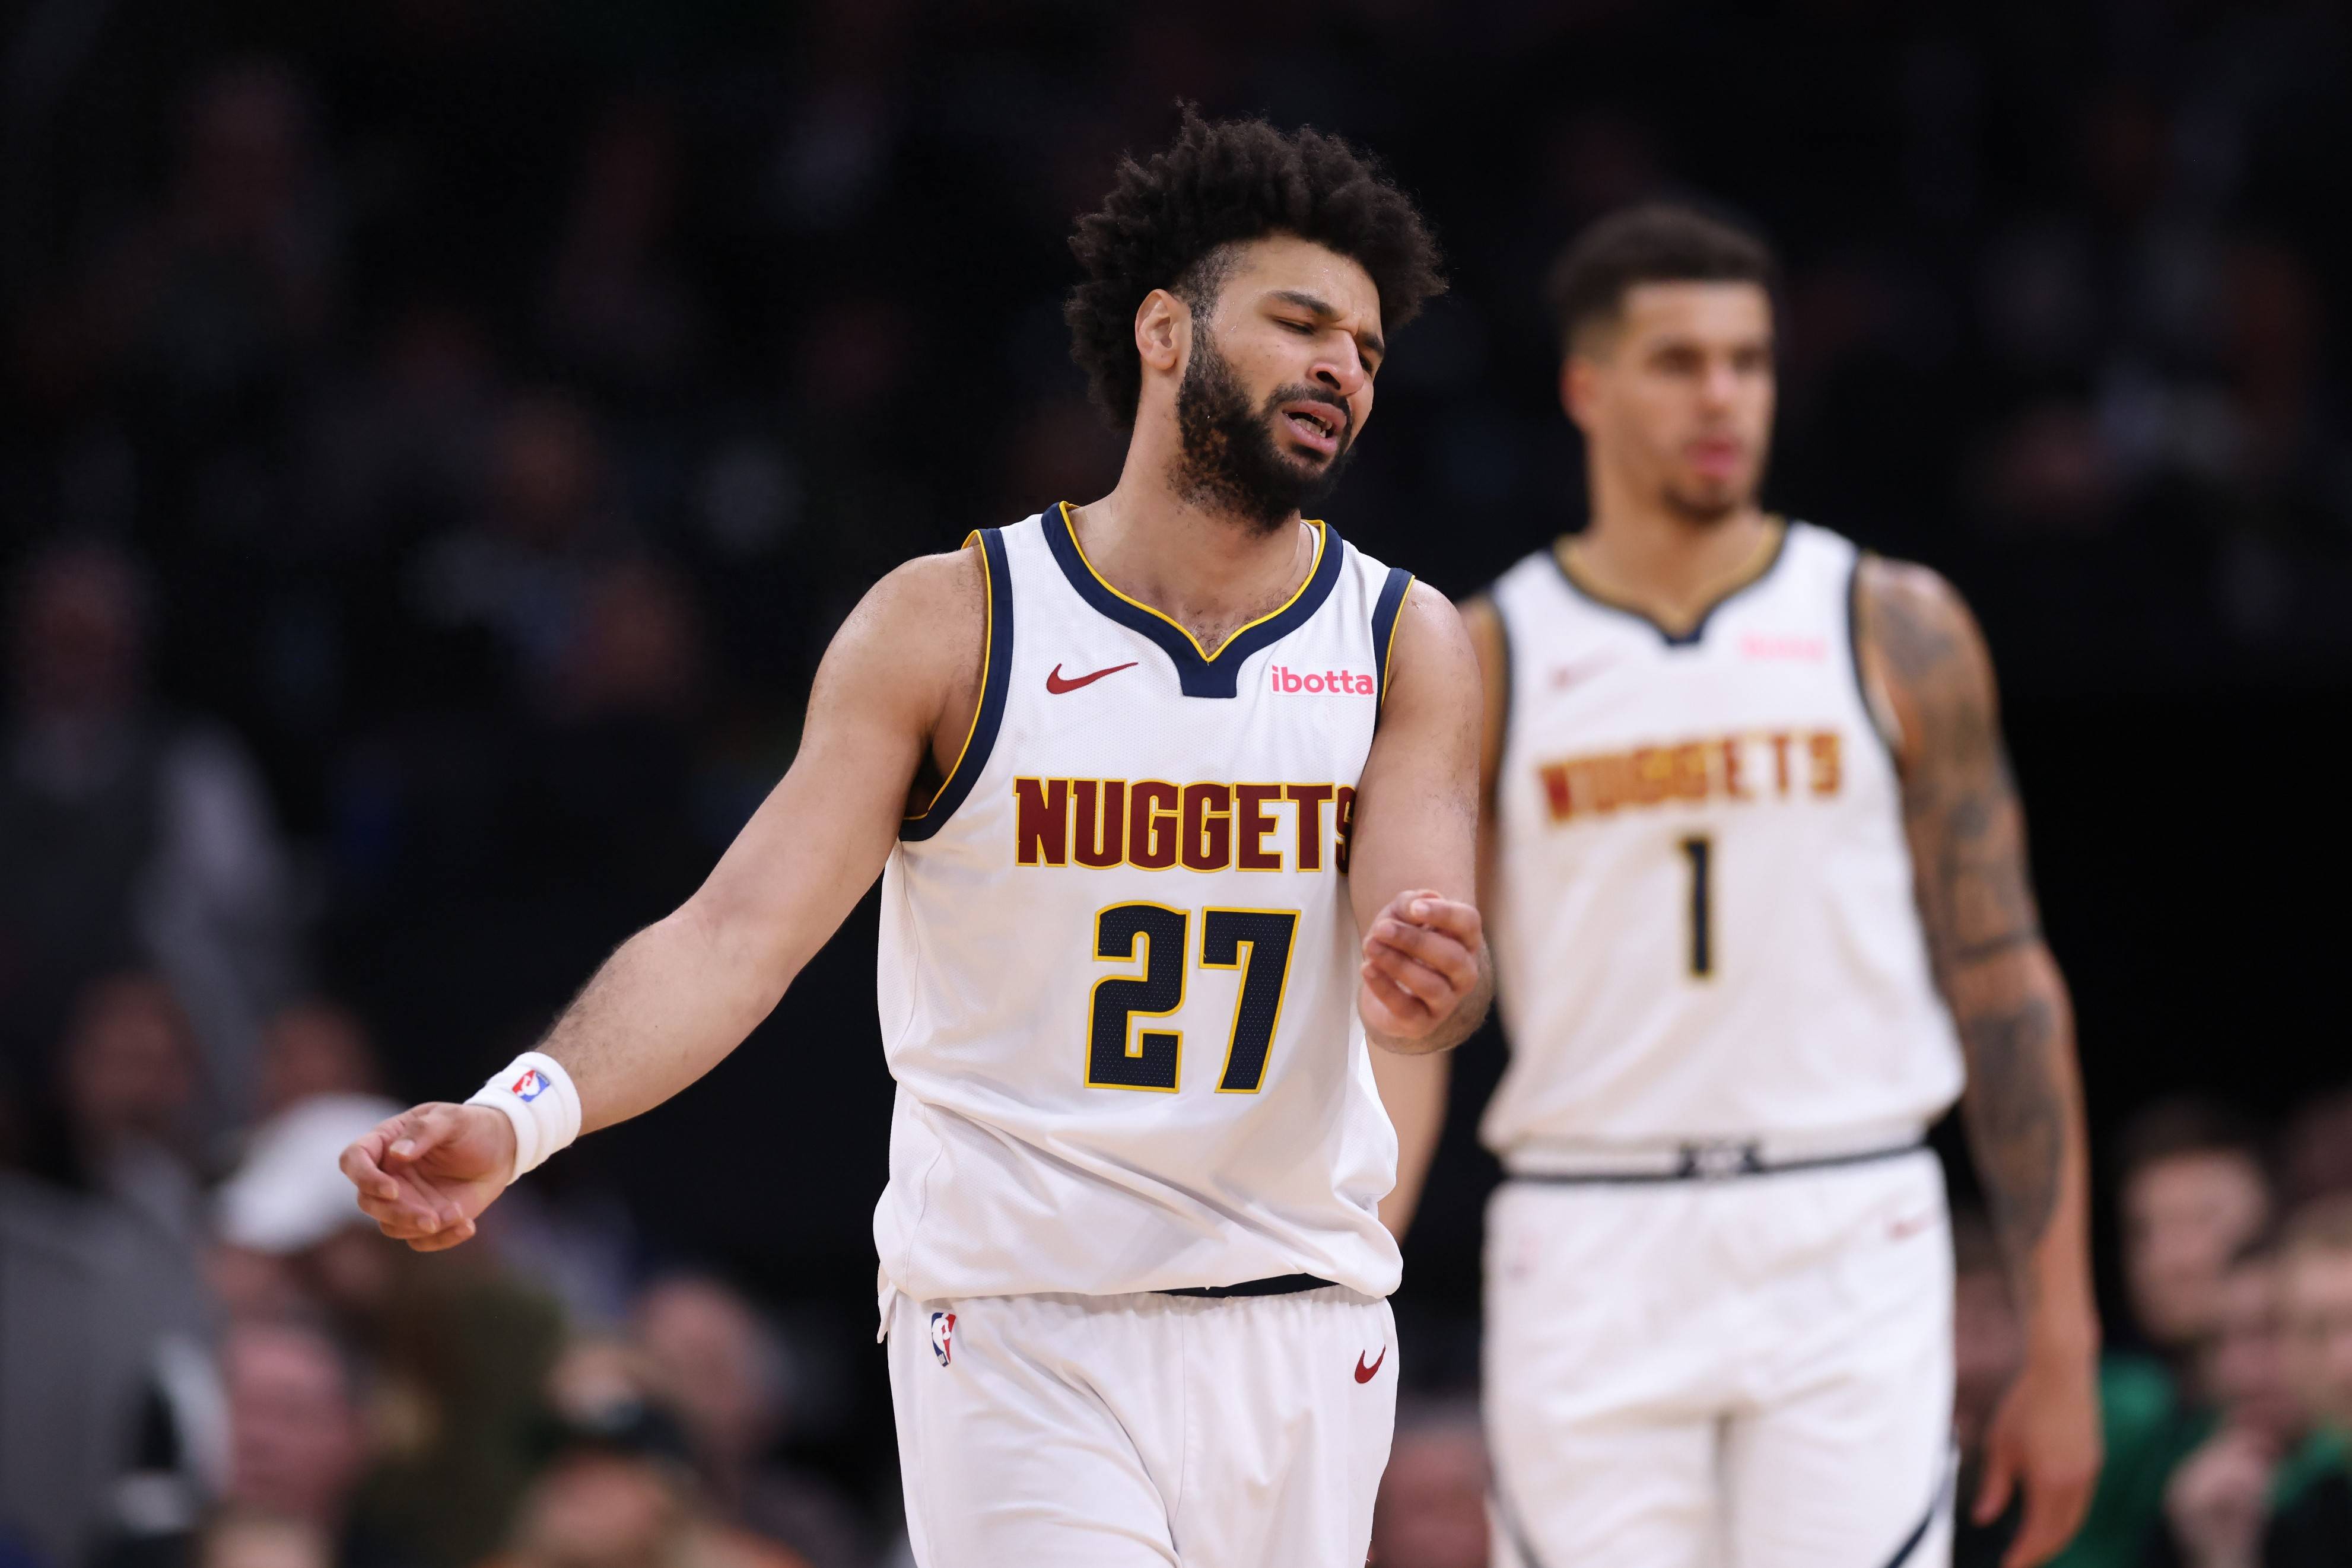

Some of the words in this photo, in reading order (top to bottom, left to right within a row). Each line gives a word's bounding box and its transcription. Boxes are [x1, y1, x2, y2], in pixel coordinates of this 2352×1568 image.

[1272, 664, 1374, 695] ibotta
[1676, 835, 1712, 982] 1
[1084, 900, 1301, 1093] 27
